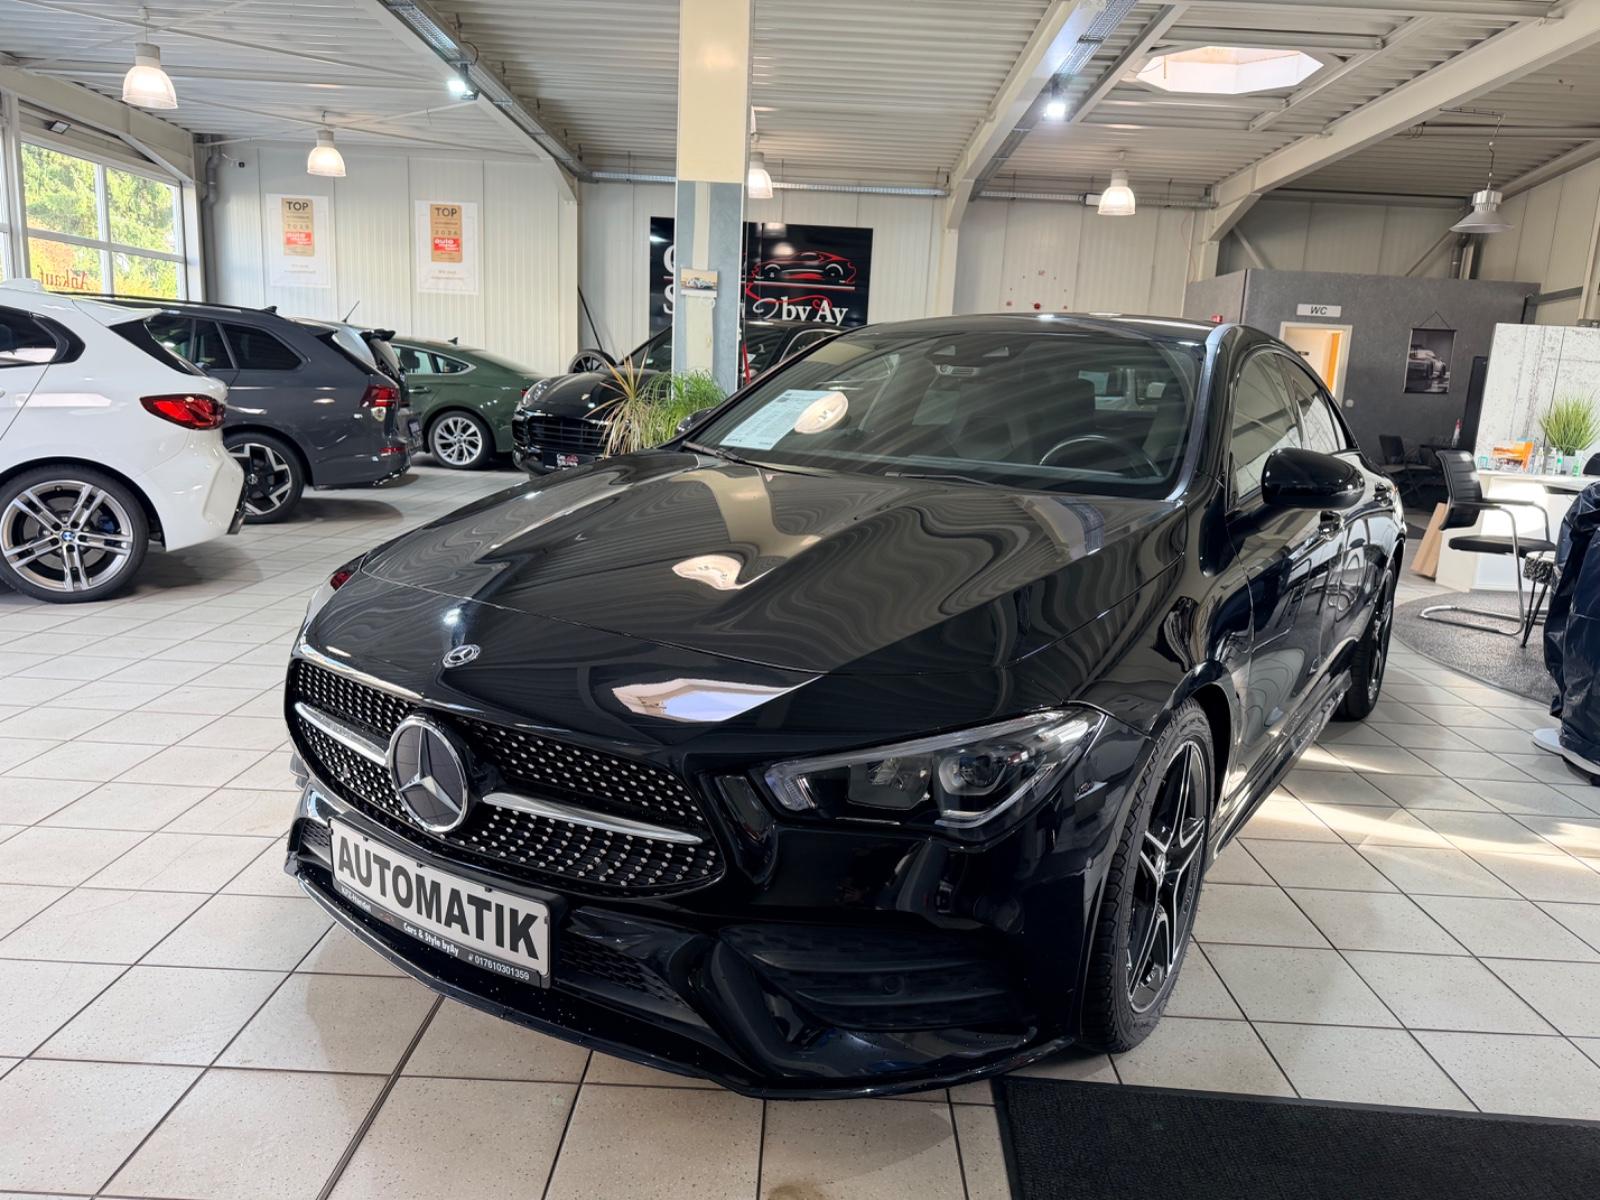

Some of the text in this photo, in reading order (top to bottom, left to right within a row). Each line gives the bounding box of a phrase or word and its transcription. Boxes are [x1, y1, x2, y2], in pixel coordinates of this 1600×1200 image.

[286, 201, 309, 212] TOP
[435, 207, 458, 217] TOP
[815, 299, 849, 326] Ay
[1310, 306, 1328, 315] WC
[338, 835, 540, 961] AUTOMATIK
[402, 922, 418, 936] Cars
[418, 930, 424, 939] &
[424, 932, 440, 948] Style
